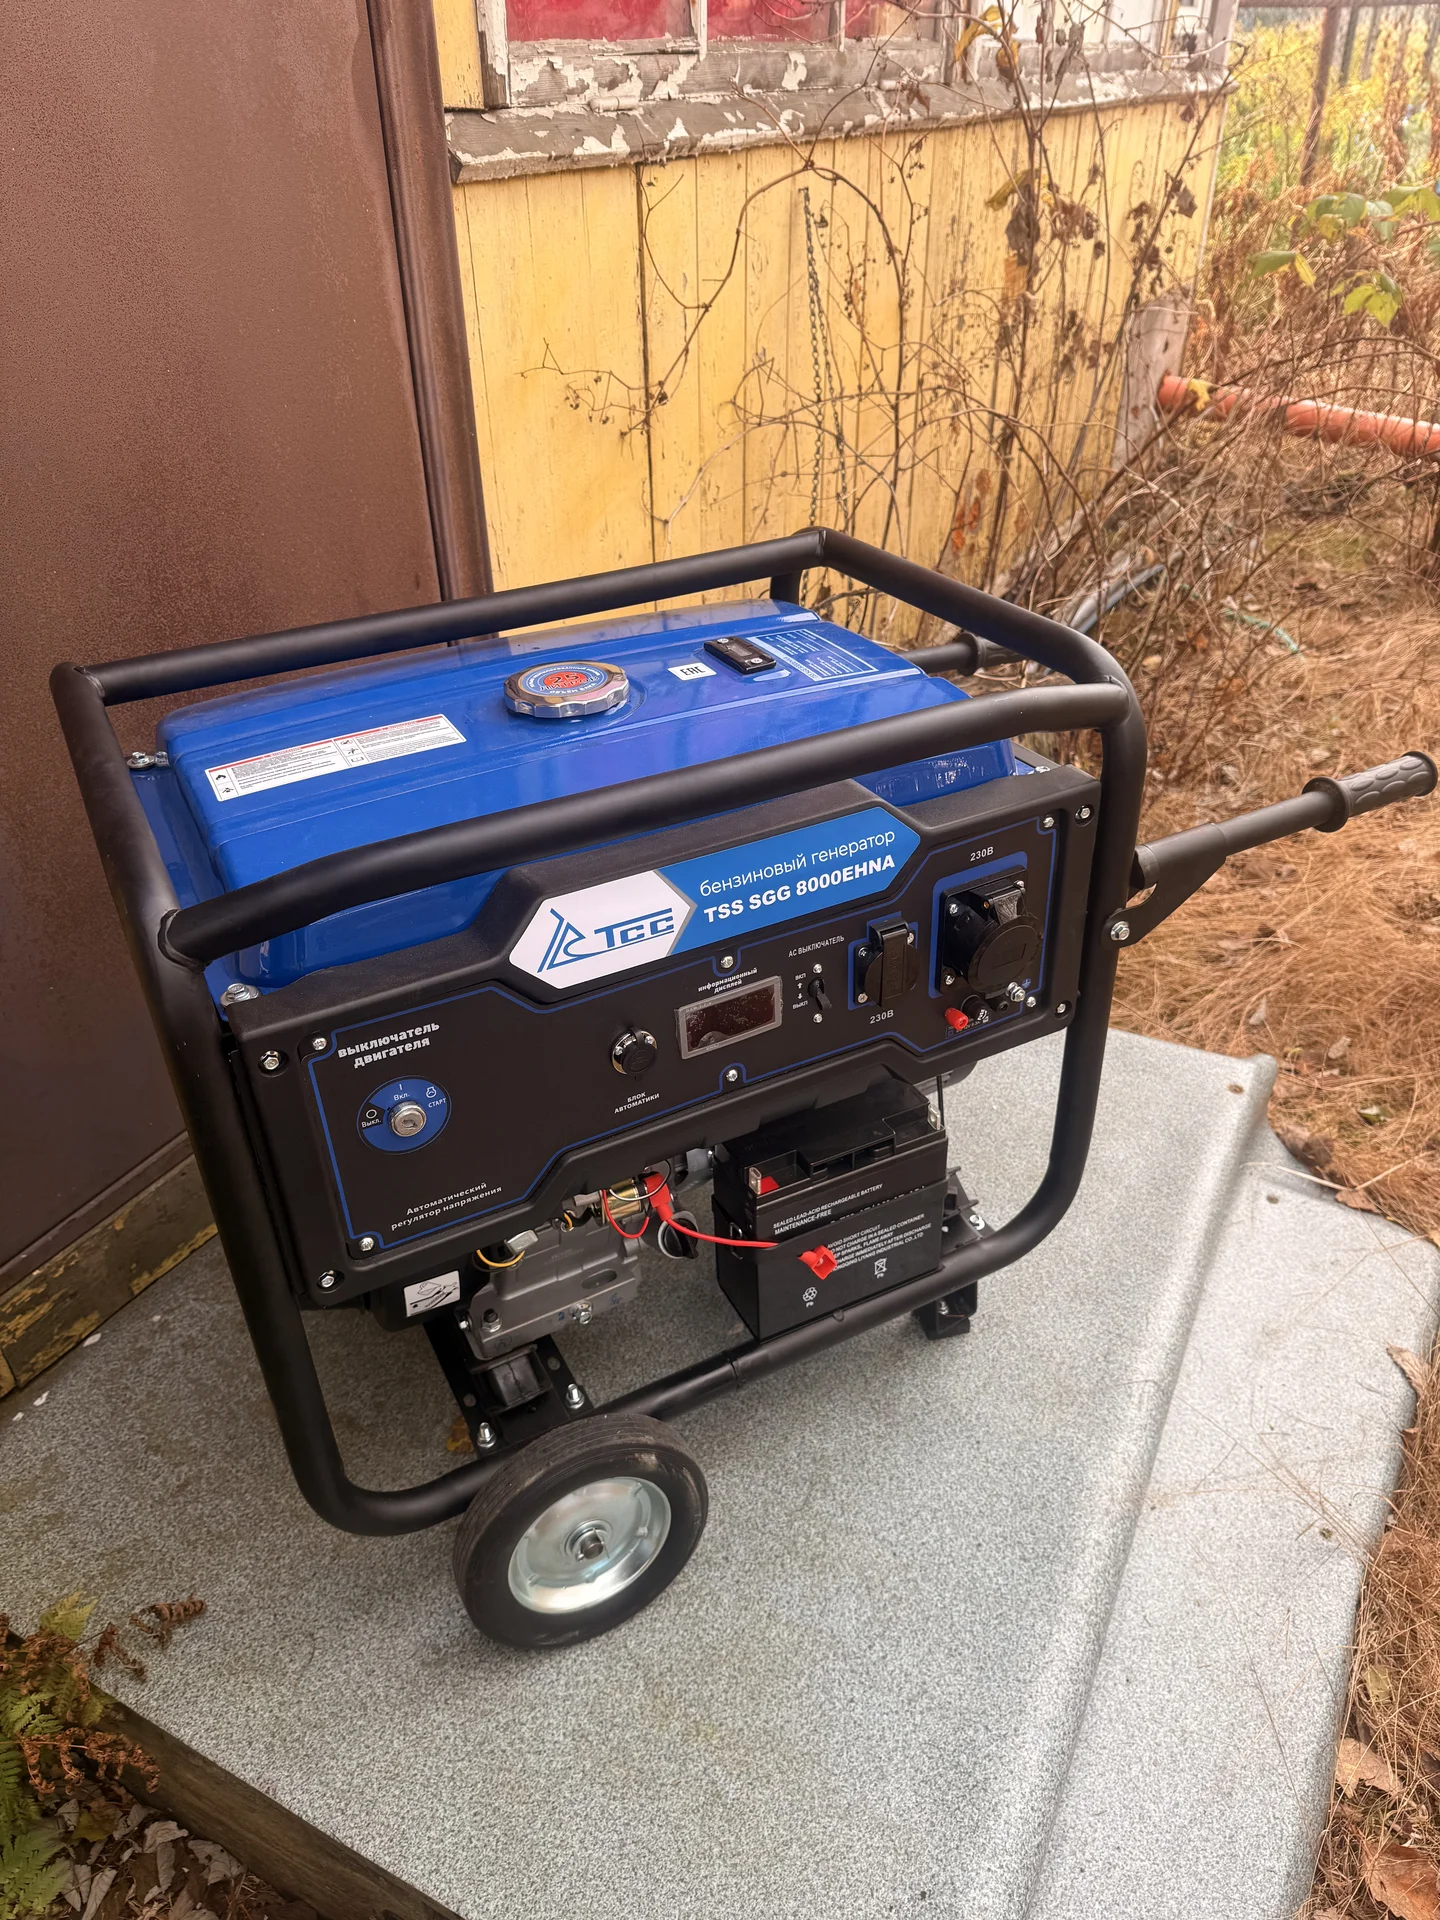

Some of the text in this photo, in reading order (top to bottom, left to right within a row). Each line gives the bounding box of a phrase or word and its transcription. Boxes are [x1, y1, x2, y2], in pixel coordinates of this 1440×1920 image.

[549, 672, 580, 684] 25
[699, 830, 896, 897] бензиновый генератор
[703, 854, 896, 923] TSS SGG 8000EHNA
[798, 935, 845, 955] ВЫКЛЮЧАТЕЛЬ
[698, 967, 758, 992] информационный
[714, 979, 742, 994] дисплей
[353, 1037, 430, 1069] двигателя
[614, 1093, 660, 1114] АВТОМАТИКИ
[627, 1092, 646, 1103] БЛОК
[391, 1186, 502, 1231] регулятор напряжения
[406, 1182, 487, 1215] Автоматический
[773, 1183, 883, 1229] SEALED LEAD-ACID RECHARGEABLE BATTERY
[774, 1209, 832, 1235] MAINTENANCE-FREE
[877, 1224, 897, 1236] SEALED
[897, 1213, 925, 1228] CONTAINER
[903, 1222, 932, 1238] DISCHARGE
